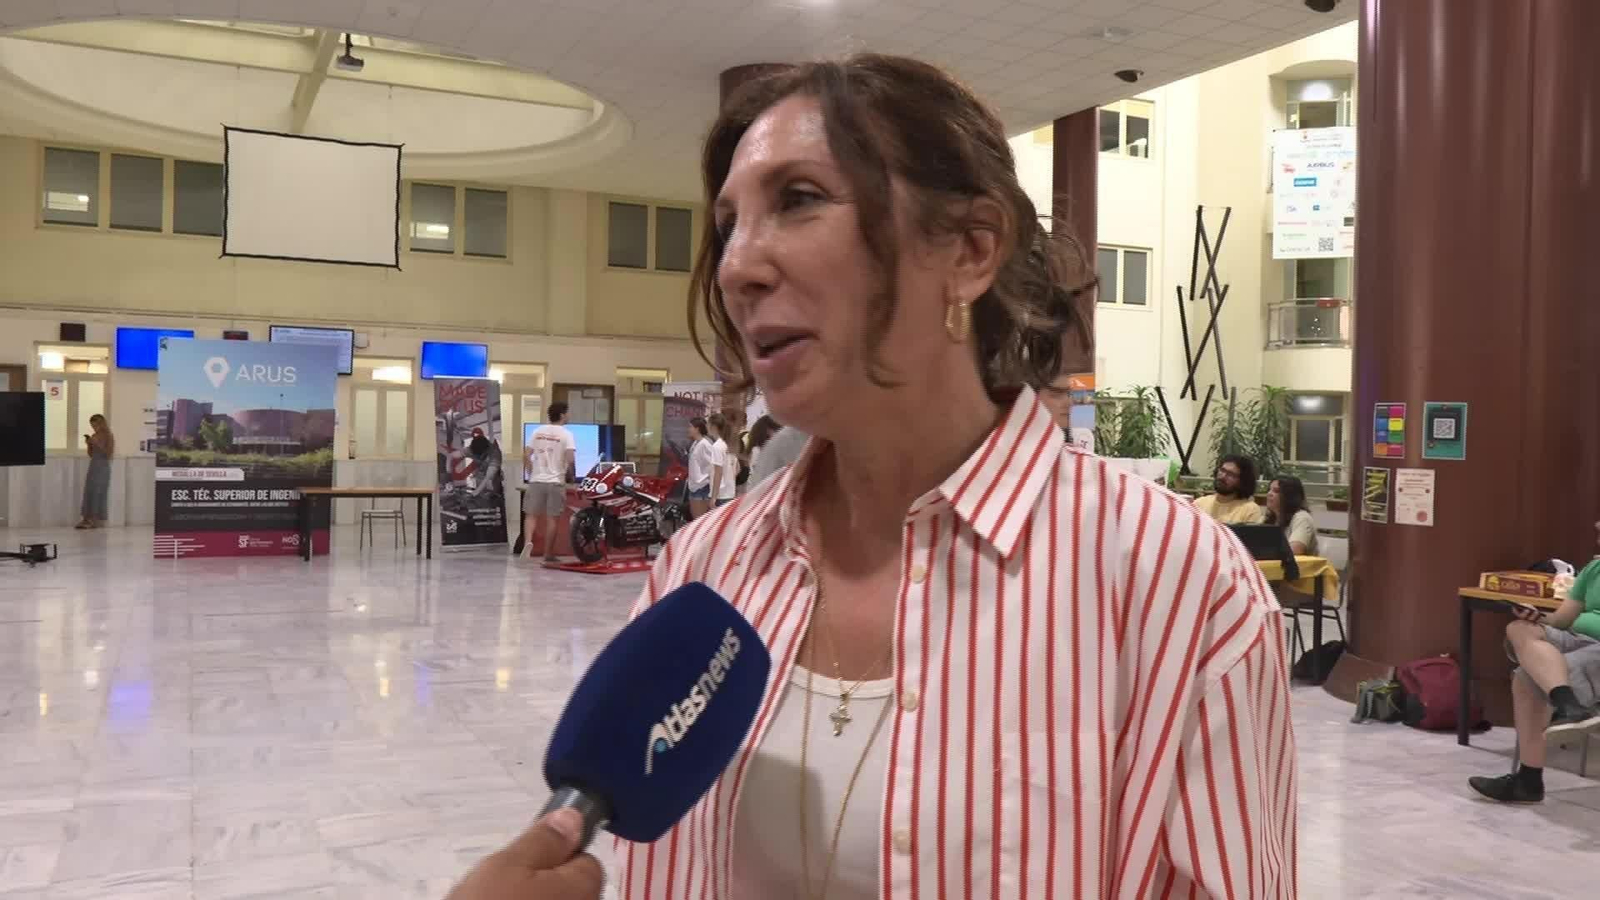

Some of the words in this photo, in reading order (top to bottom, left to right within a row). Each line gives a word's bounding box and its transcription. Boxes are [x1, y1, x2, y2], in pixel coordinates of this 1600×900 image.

[235, 364, 296, 382] ARUS
[51, 387, 59, 396] 5
[440, 385, 487, 400] MADE
[674, 391, 700, 401] NOT
[465, 400, 485, 414] US
[171, 489, 191, 500] ESC.
[193, 487, 211, 500] TÉC.
[213, 489, 255, 500] SUPERIOR
[257, 489, 268, 500] DE
